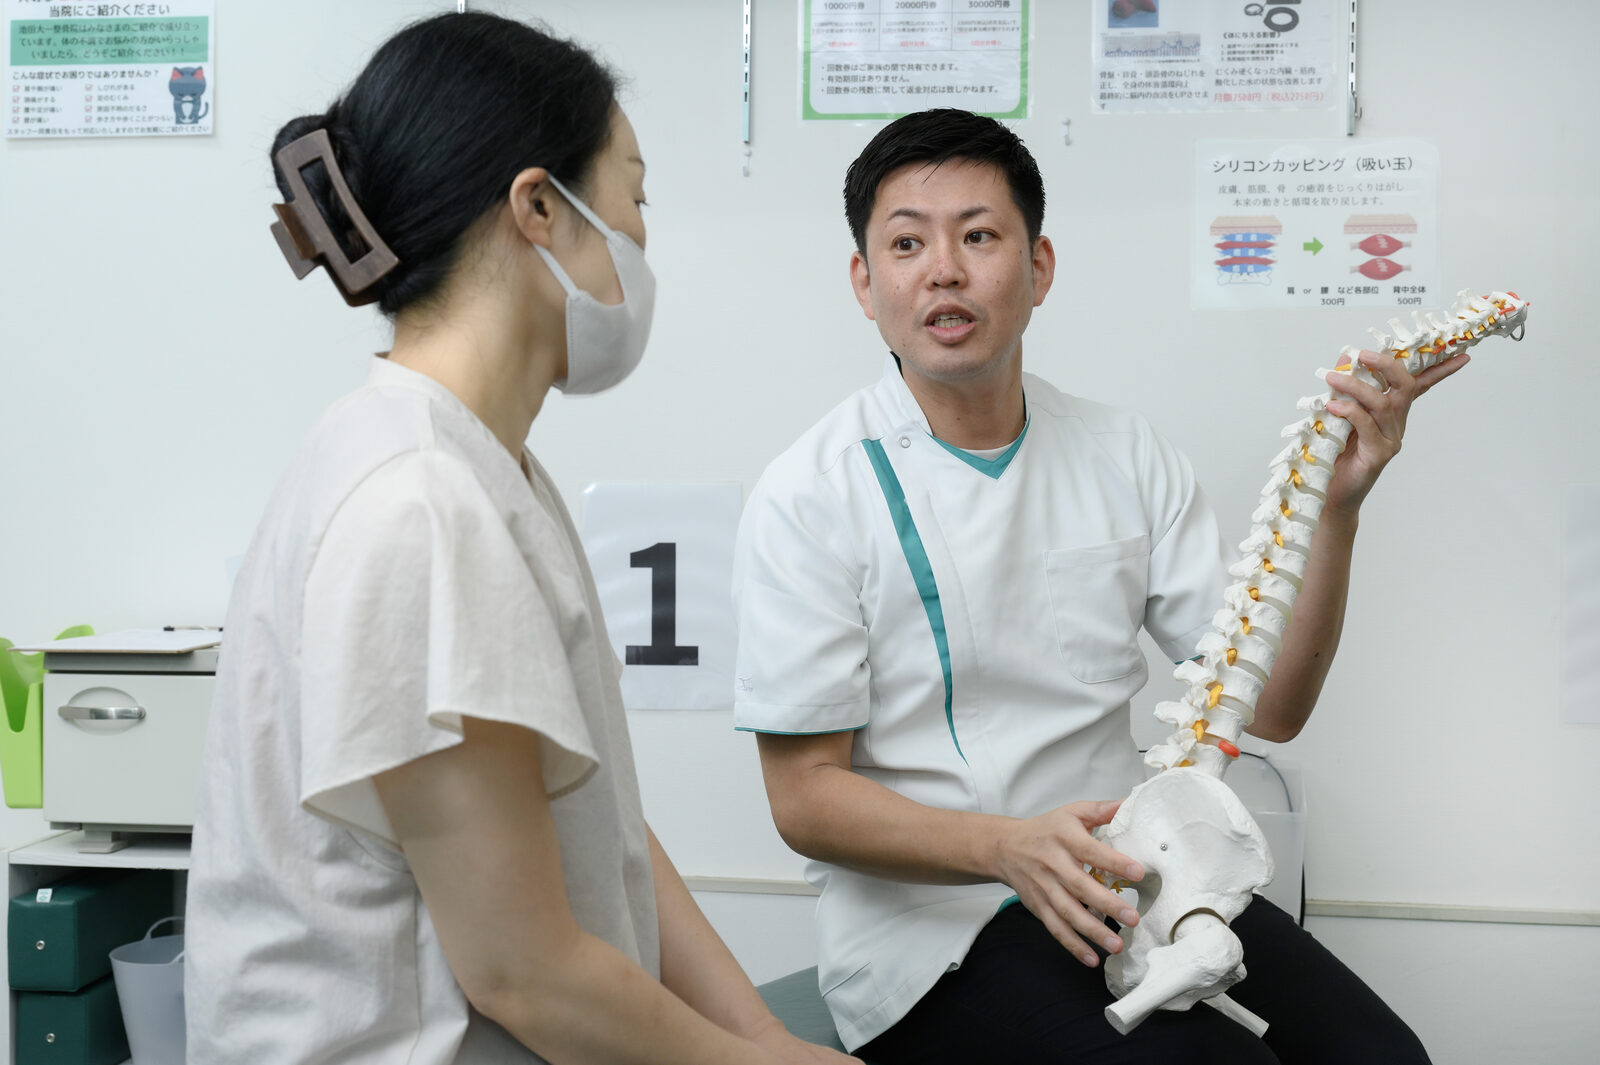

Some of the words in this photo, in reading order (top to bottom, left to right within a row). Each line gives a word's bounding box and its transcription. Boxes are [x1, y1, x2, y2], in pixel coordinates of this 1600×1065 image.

[50, 4, 170, 17] 当院にご紹介ください
[12, 69, 159, 80] こんな症状でお困りではありませんか？
[1320, 298, 1345, 306] 300円
[1397, 297, 1422, 305] 500円
[626, 542, 698, 665] 1
